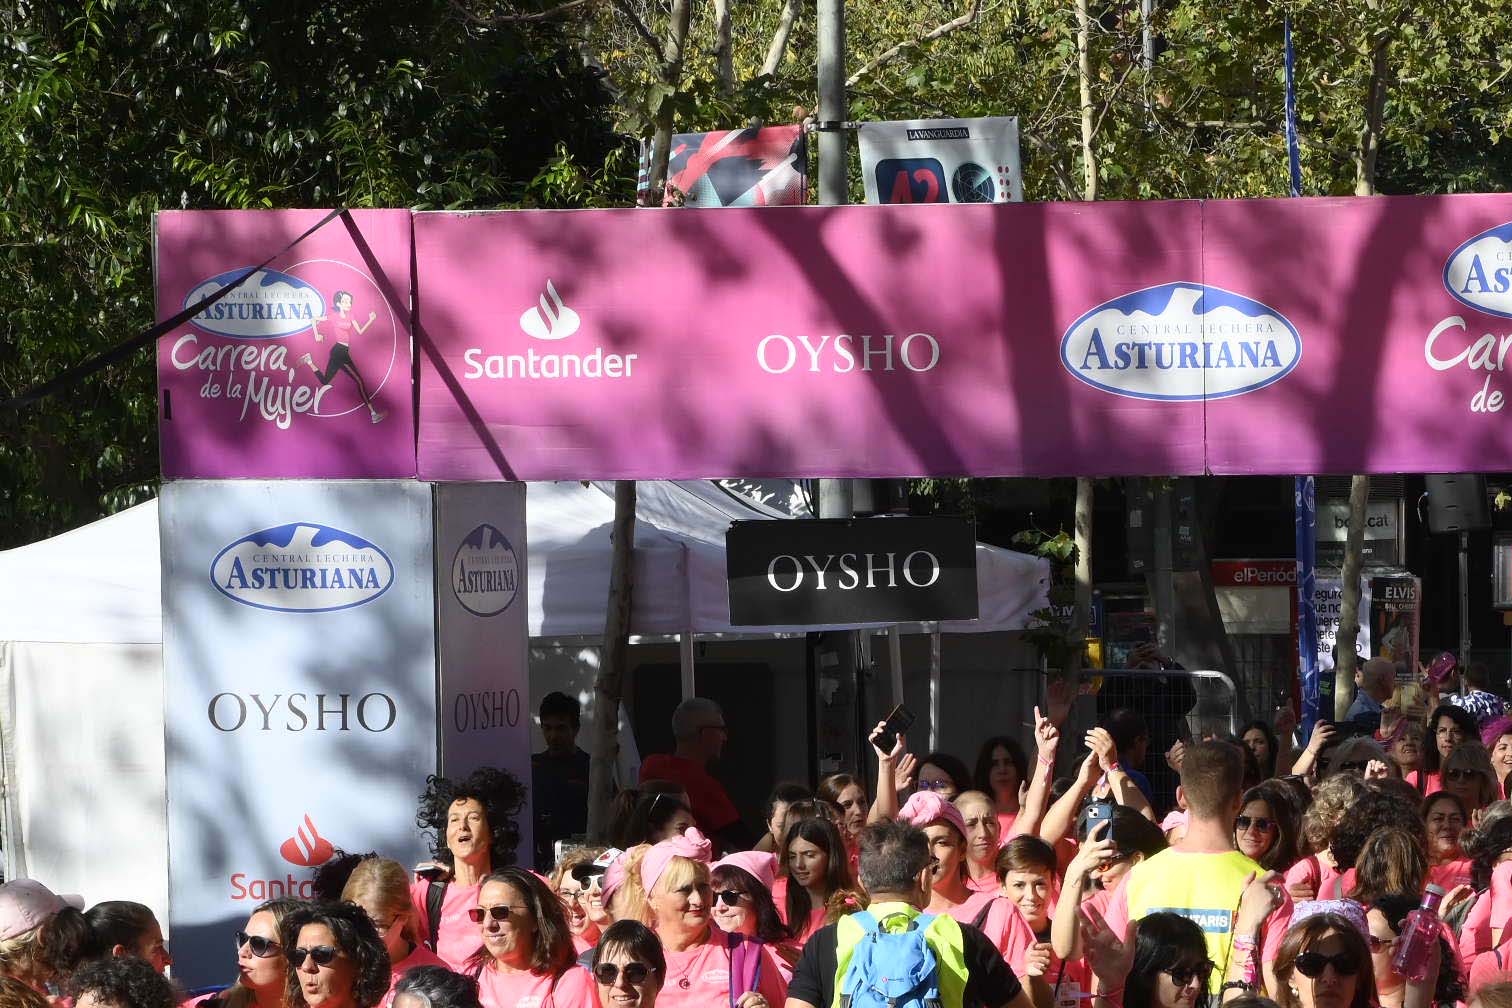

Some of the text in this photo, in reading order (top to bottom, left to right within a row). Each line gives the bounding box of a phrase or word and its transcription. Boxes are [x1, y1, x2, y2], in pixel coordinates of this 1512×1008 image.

[1117, 321, 1275, 336] CENTRAL LECHERA
[171, 334, 288, 371] Carrera
[464, 347, 638, 379] Santander
[756, 332, 940, 374] OYSHO
[1079, 328, 1282, 370] ASTURIANA
[200, 368, 333, 429] de la Mujer
[1470, 374, 1504, 413] de
[225, 556, 381, 590] ASTURIANA
[253, 553, 375, 563] CENTRAL LECHERA
[767, 550, 940, 592] OYSHO
[457, 567, 515, 595] ASTURIANA
[1386, 586, 1416, 600] ELVIS
[208, 692, 397, 732] OYSHO
[454, 688, 519, 733] OYSHO
